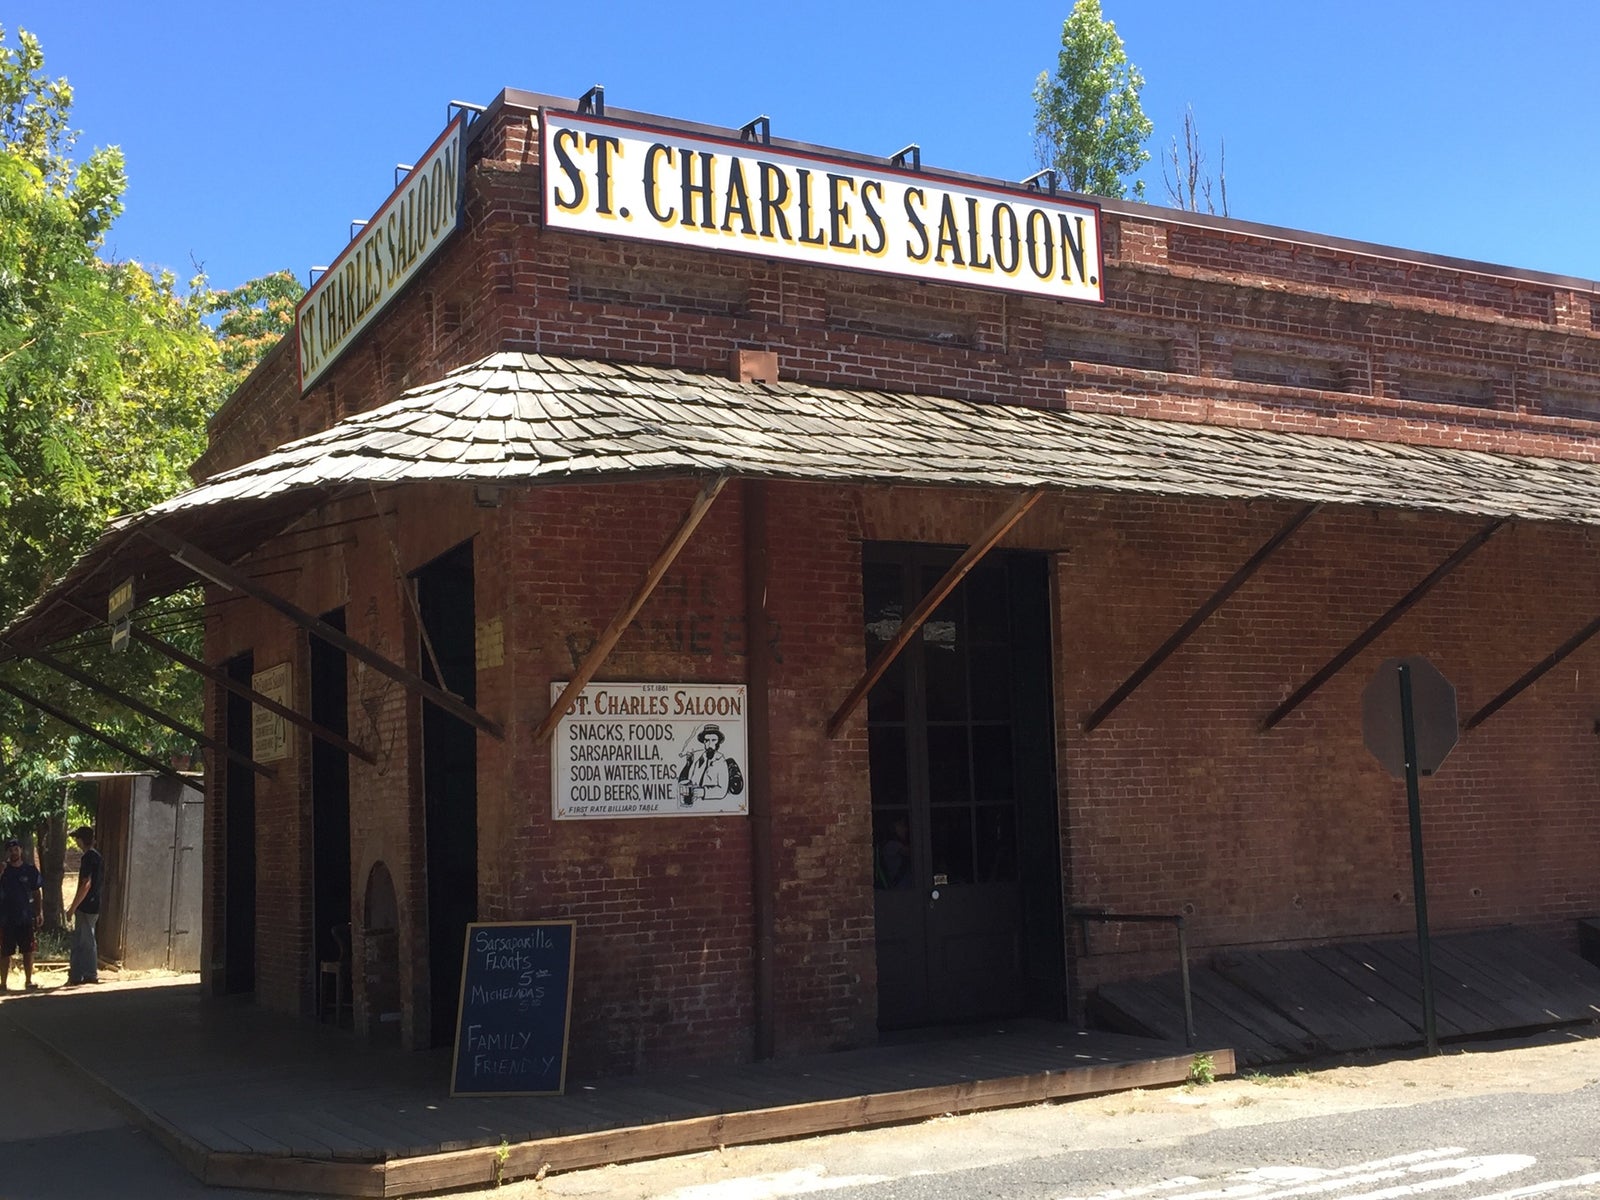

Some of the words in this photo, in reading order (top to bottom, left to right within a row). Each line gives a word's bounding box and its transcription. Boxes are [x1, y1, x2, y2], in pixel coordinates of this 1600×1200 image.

[552, 128, 637, 219] ST.
[642, 143, 888, 257] CHARLES
[903, 185, 1099, 287] SALOON.
[301, 304, 320, 381] ST.
[318, 226, 384, 356] CHARLES
[594, 690, 669, 716] CHARLES
[673, 690, 742, 716] SALOON
[569, 723, 626, 743] SNACKS,
[628, 723, 675, 742] FOODS,
[569, 744, 664, 762] SARSAPARILLA,
[570, 765, 602, 782] SODA
[604, 764, 650, 782] WATERS,
[570, 785, 601, 802] COLD
[604, 784, 641, 802] BEERS,
[568, 806, 588, 814] FIRST
[589, 805, 607, 813] RATE
[607, 804, 638, 813] BILLIARD
[638, 804, 659, 812] TABLE
[468, 1024, 532, 1052] FAMILY
